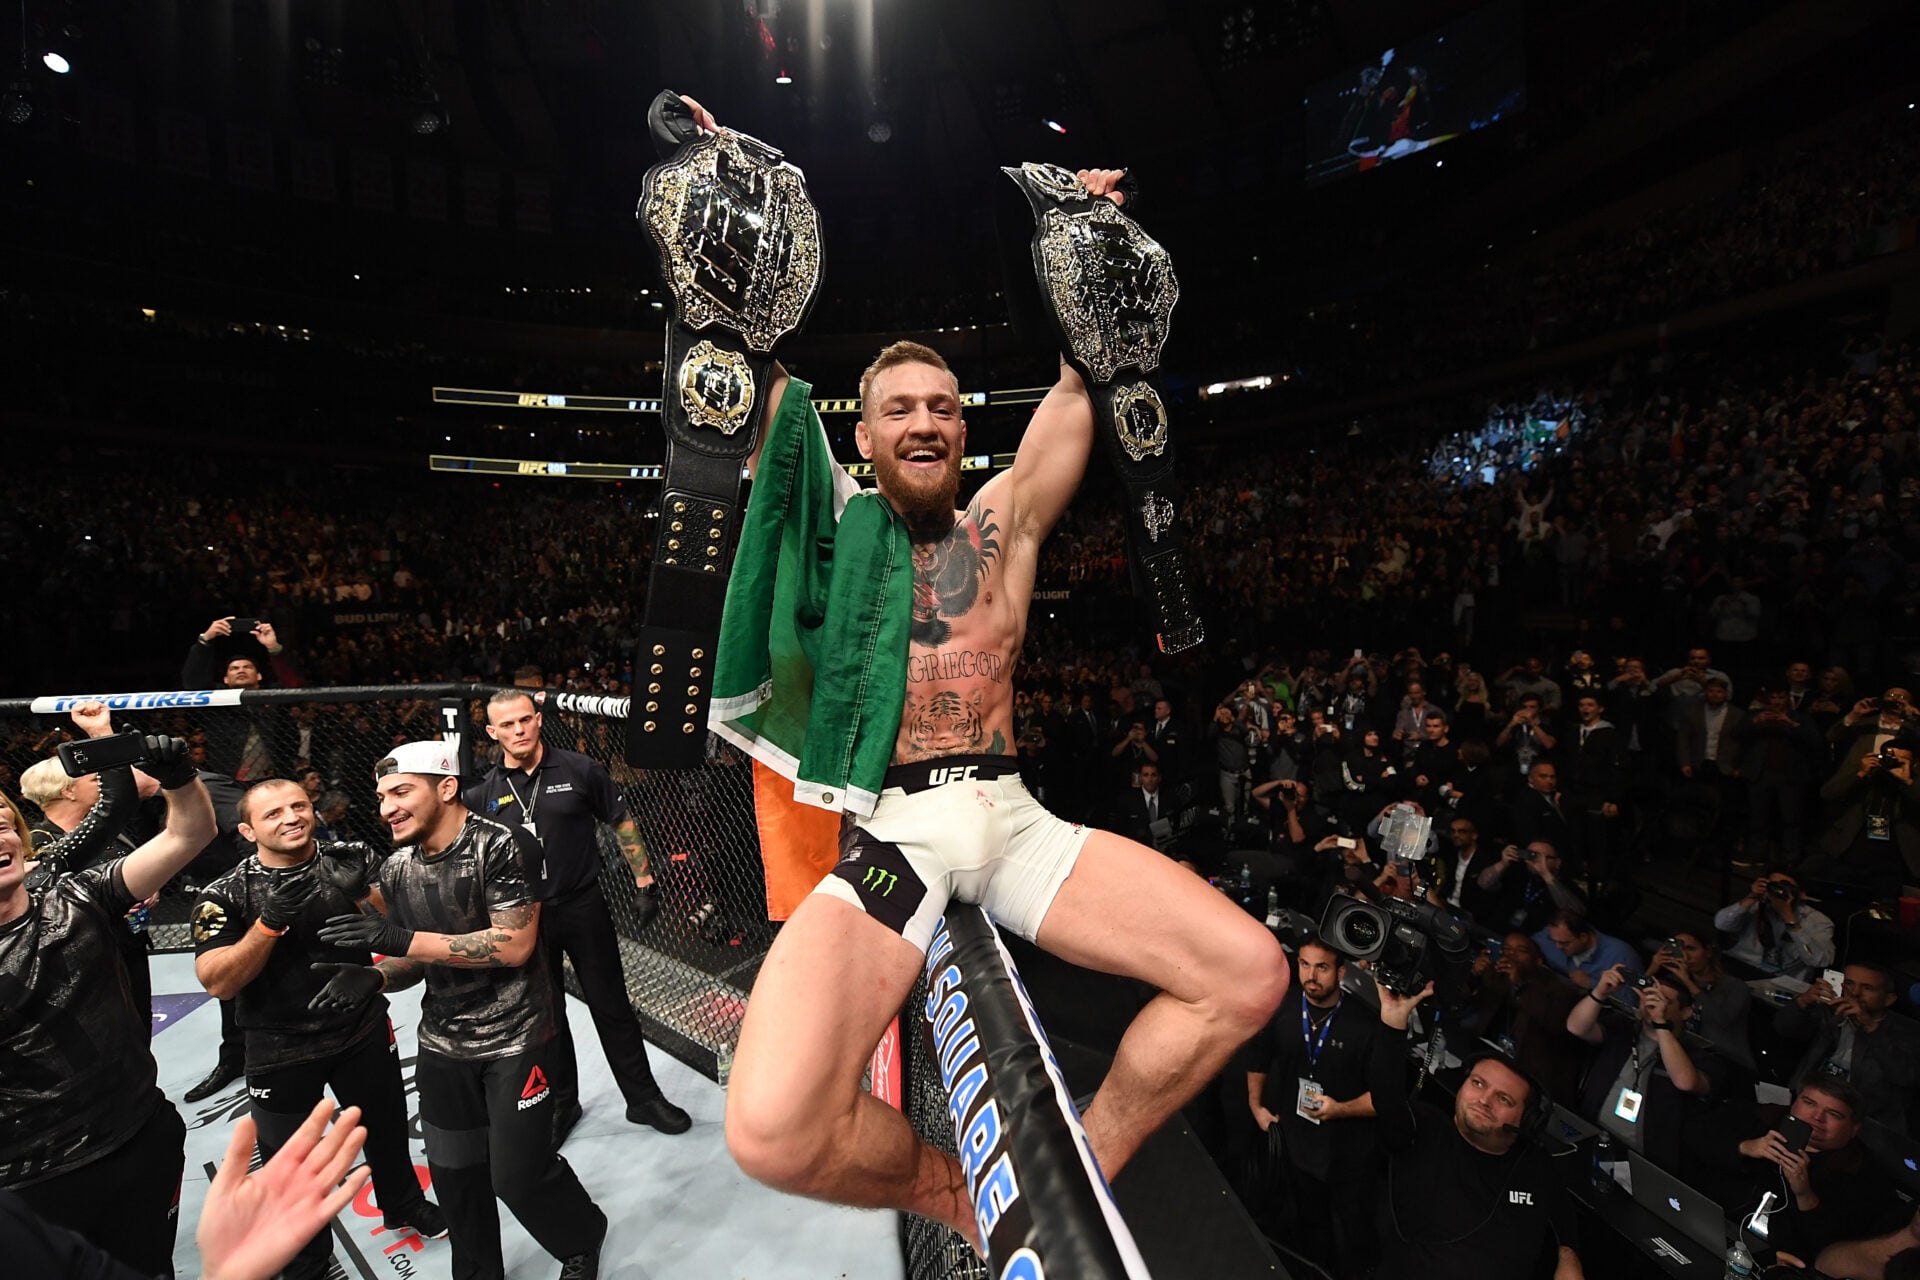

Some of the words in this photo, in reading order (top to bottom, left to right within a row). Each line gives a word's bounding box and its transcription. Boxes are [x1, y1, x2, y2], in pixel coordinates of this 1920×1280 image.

[518, 393, 547, 406] UFC
[518, 461, 547, 474] UFC
[135, 691, 214, 708] TIRES
[928, 765, 979, 786] UFC
[249, 1086, 271, 1099] UFC
[925, 964, 1020, 1258] SQUARE
[1509, 1190, 1534, 1206] UFC
